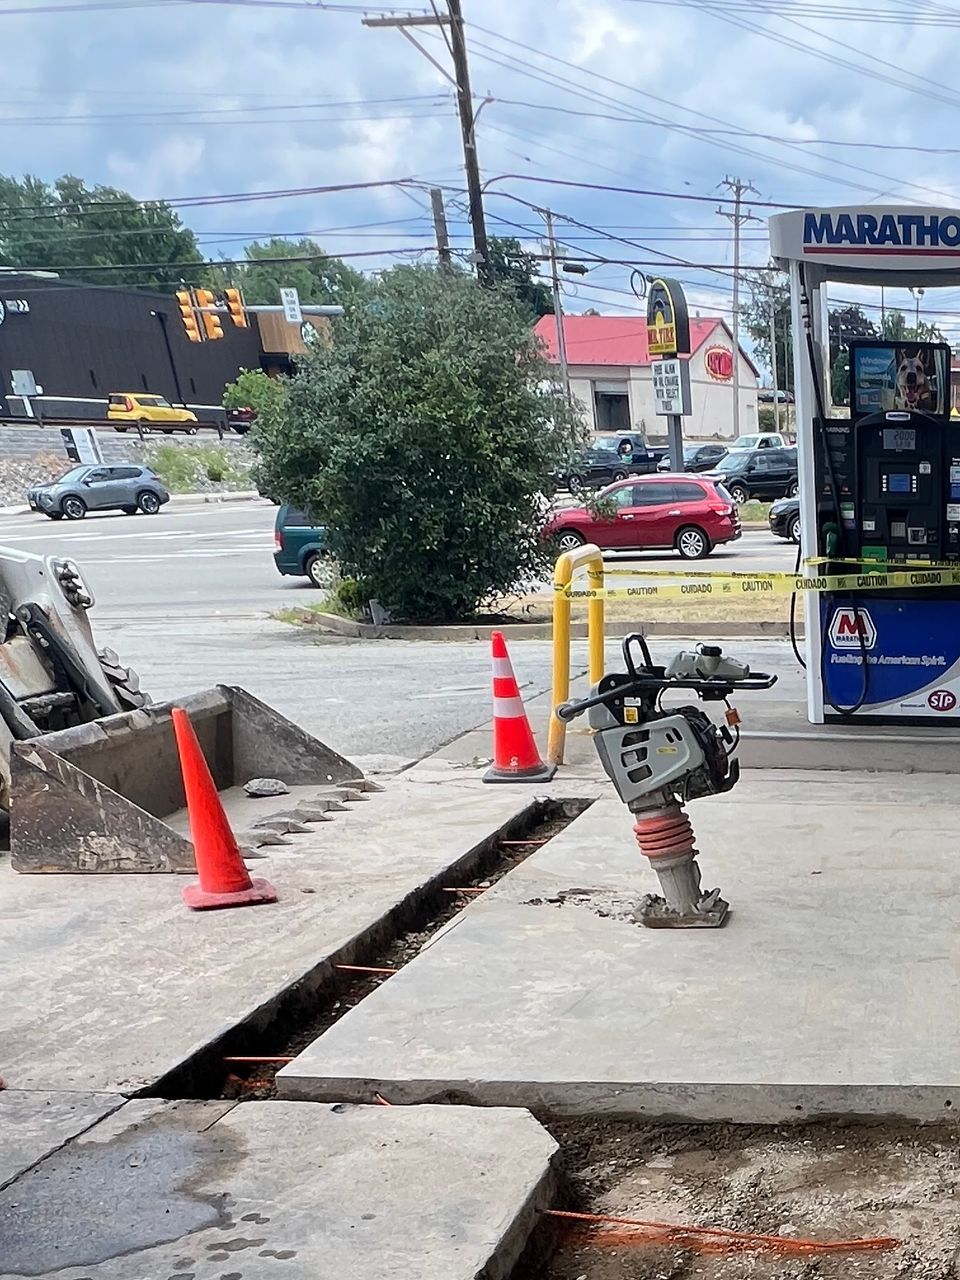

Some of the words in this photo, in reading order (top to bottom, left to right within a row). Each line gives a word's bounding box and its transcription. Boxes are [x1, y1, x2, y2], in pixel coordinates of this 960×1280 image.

[627, 586, 658, 596] CAUTION
[681, 584, 712, 594] CUIDADO
[742, 580, 773, 592] CAUTION
[796, 577, 827, 590] CUIDADO
[857, 575, 888, 587] CAUTION
[910, 572, 942, 584] CUIDADO
[830, 653, 863, 665] Fueling
[878, 655, 921, 665] American
[921, 655, 946, 666] Spirit.
[930, 692, 953, 708] STP
